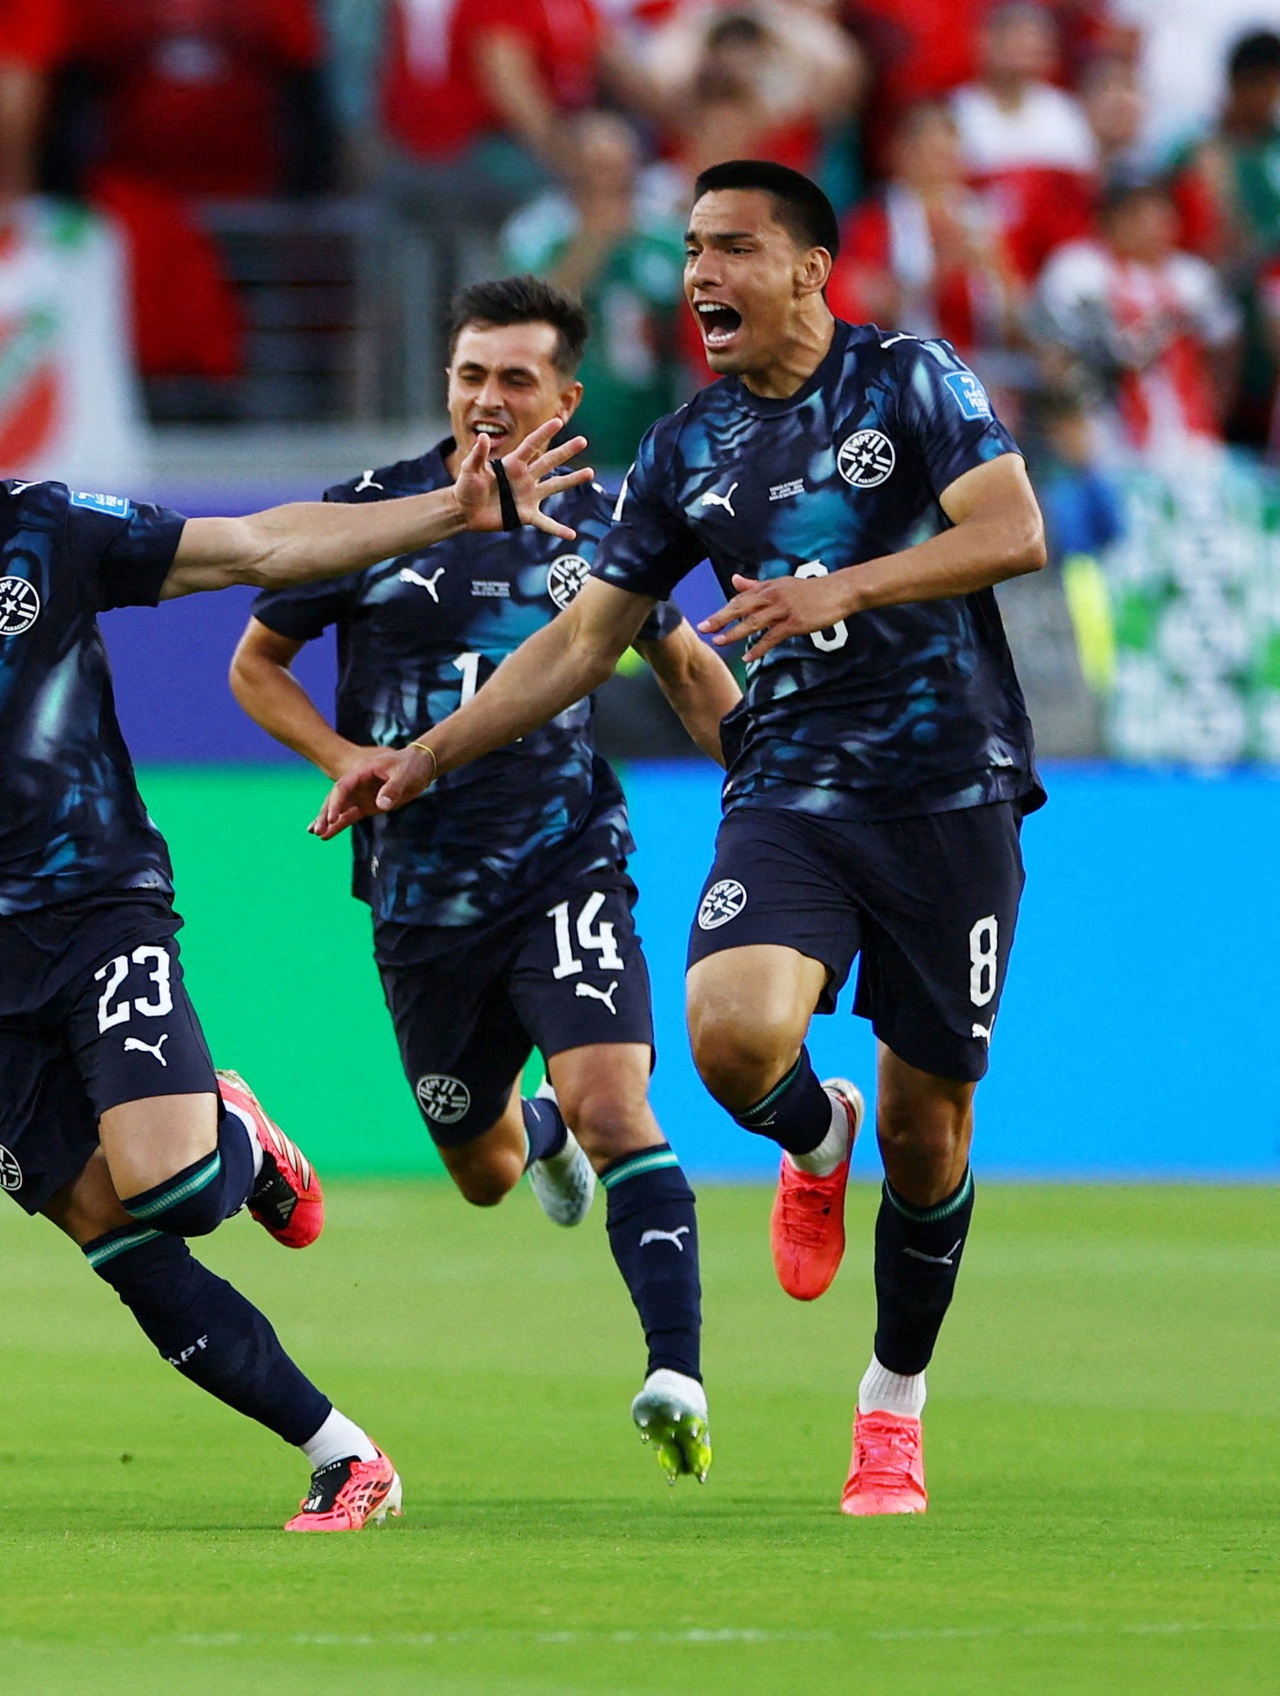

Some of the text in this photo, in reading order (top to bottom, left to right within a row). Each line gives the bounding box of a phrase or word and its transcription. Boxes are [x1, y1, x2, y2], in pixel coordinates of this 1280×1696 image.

[546, 891, 624, 980] 14
[970, 914, 998, 1007] 8
[94, 946, 174, 1034] 23
